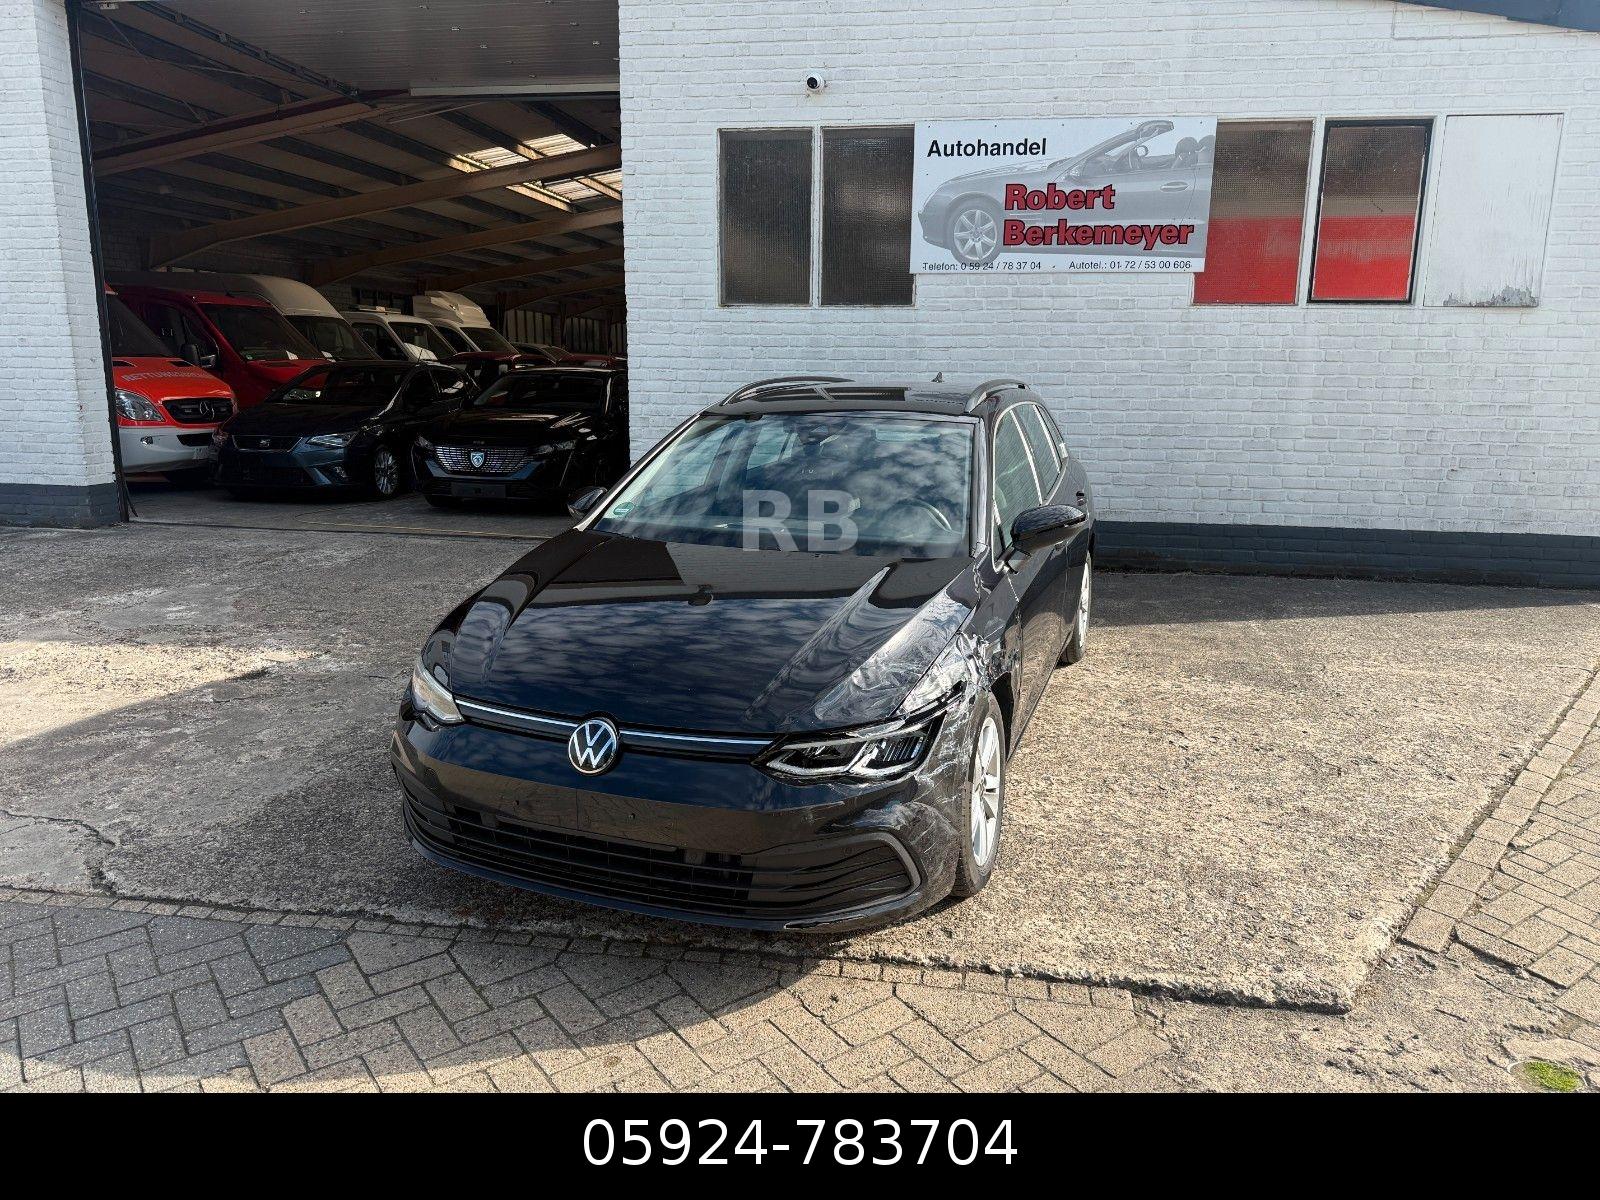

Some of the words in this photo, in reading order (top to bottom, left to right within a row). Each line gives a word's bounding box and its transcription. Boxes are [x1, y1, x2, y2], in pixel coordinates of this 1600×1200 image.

[927, 138, 1047, 157] Autohandel
[1004, 183, 1115, 210] Robert
[1003, 219, 1194, 250] Berkemeyer
[923, 262, 958, 271] Telefon:
[960, 262, 967, 271] 0
[969, 262, 980, 271] 59
[982, 262, 994, 270] 24
[1002, 261, 1014, 270] 78
[1016, 261, 1027, 270] 37
[1030, 261, 1041, 270] 04
[1069, 260, 1107, 270] Autotel.:
[1124, 260, 1136, 269] 72
[1144, 260, 1156, 269] 53
[1158, 260, 1171, 269] 00
[1173, 260, 1191, 269] 606
[568, 720, 617, 774] VW
